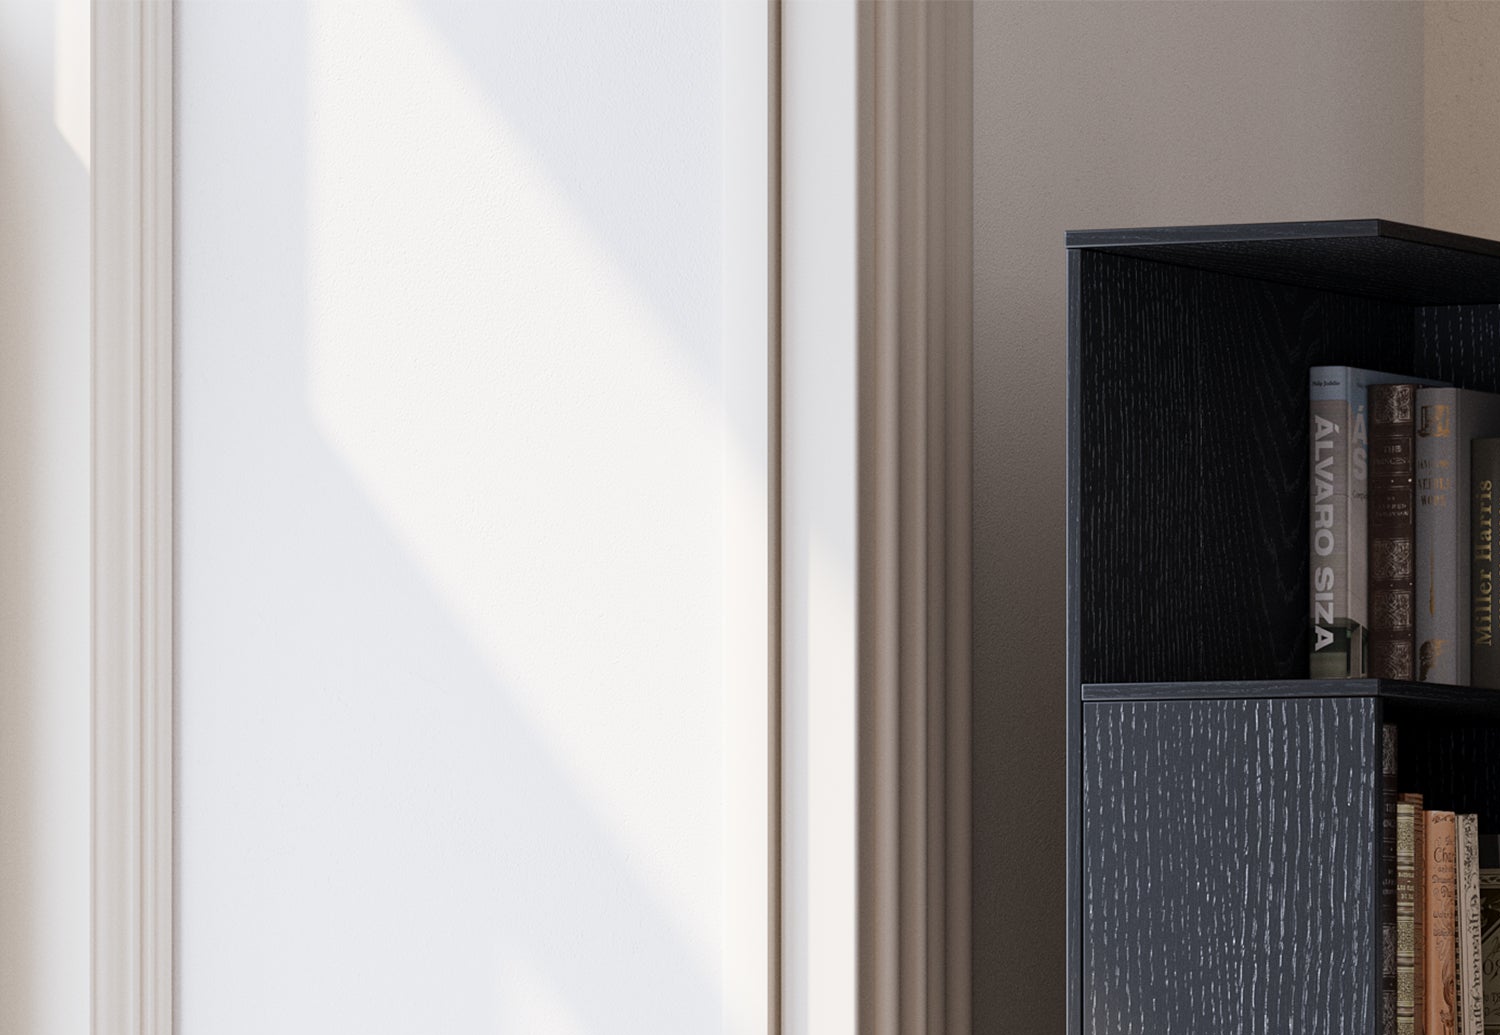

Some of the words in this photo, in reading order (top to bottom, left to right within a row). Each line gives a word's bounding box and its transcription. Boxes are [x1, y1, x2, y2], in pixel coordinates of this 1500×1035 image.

[1313, 415, 1341, 557] ÁLVARO
[1474, 479, 1492, 562] Harris
[1314, 566, 1335, 652] SIZA
[1474, 569, 1492, 647] Miller
